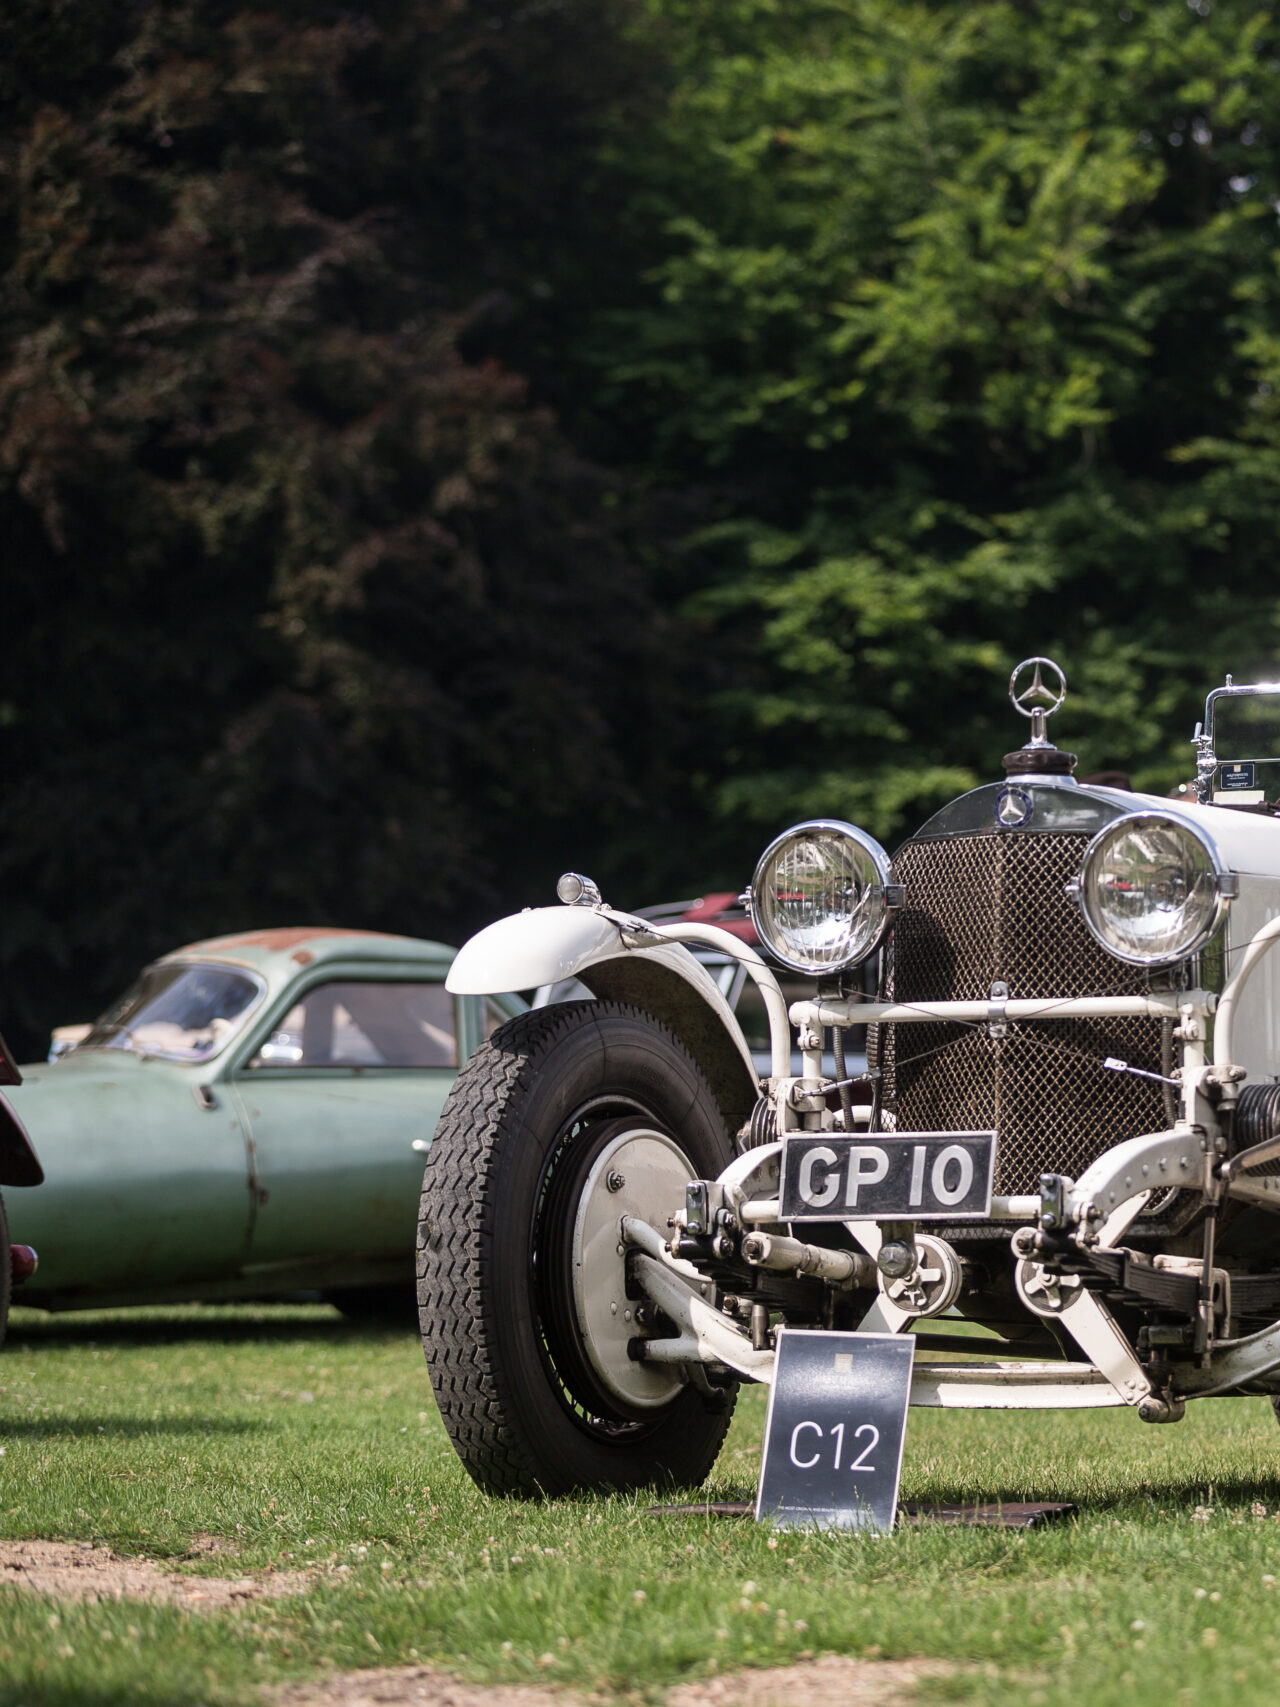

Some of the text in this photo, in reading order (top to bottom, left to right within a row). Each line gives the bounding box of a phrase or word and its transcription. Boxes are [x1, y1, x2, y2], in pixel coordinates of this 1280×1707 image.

[798, 1144, 974, 1209] GP 10
[790, 1421, 880, 1472] C12
